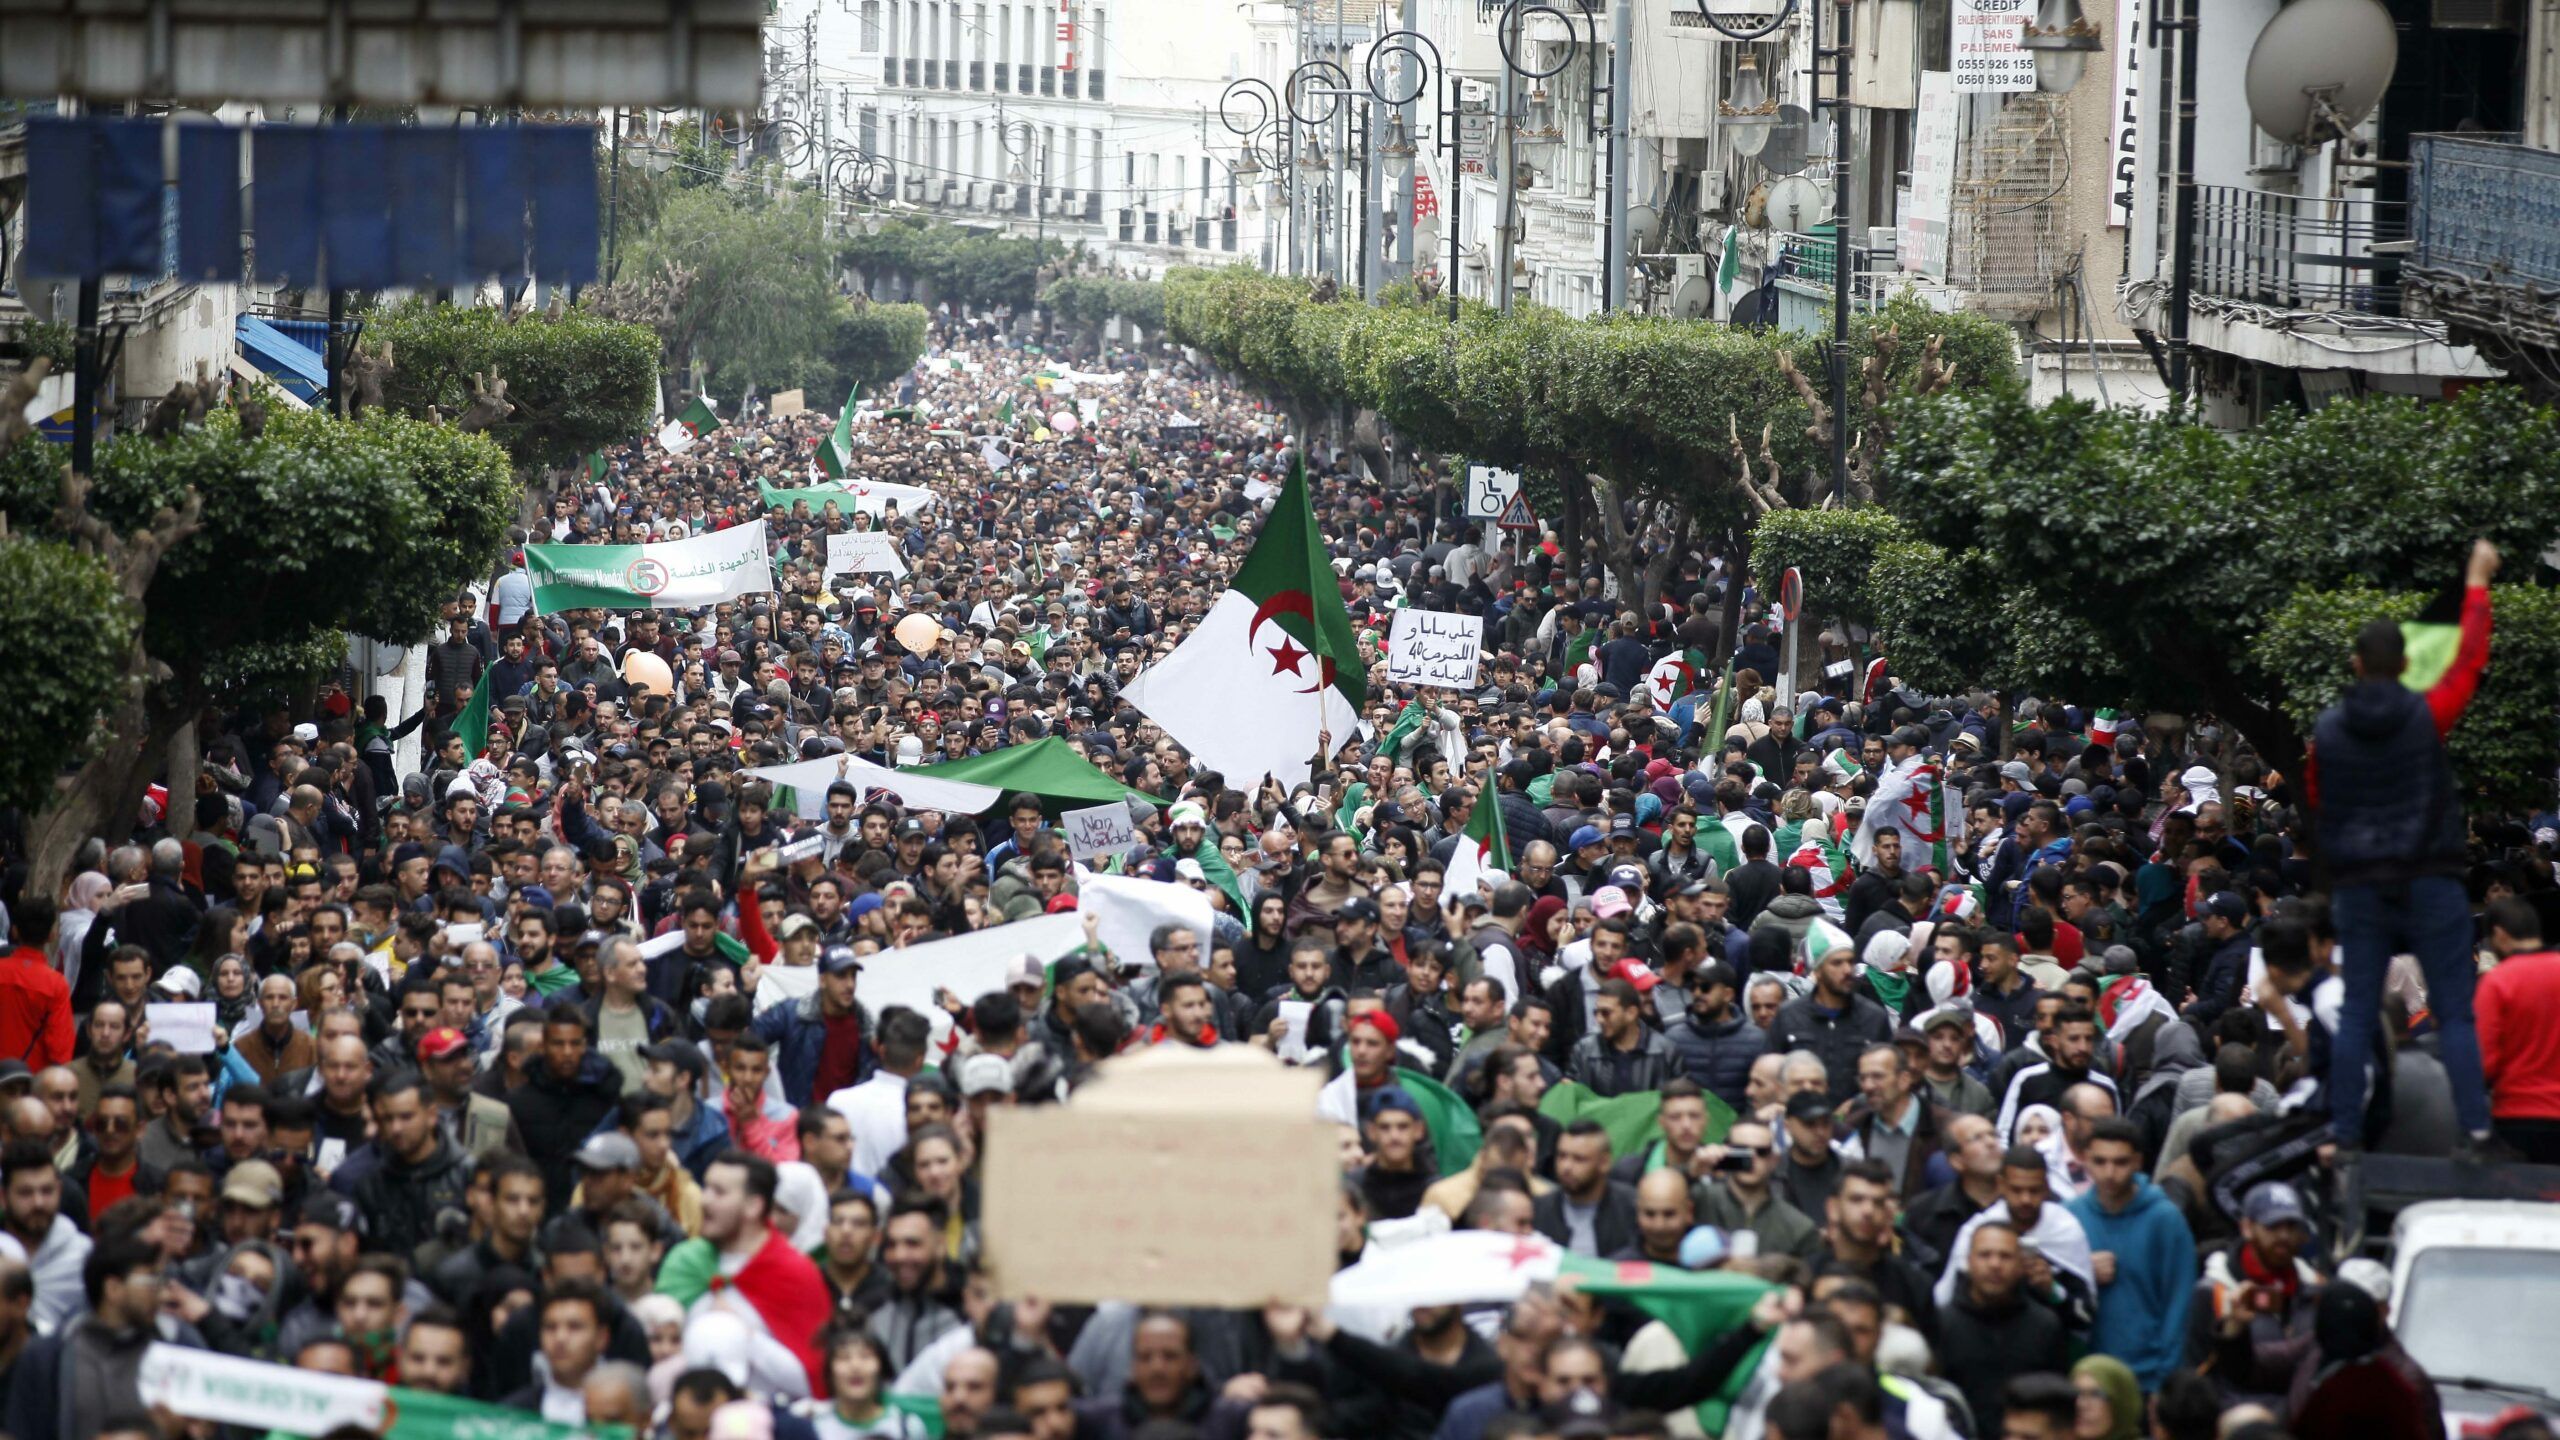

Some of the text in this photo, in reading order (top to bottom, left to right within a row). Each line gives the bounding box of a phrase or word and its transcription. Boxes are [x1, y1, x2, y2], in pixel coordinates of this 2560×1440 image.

[1974, 0, 2021, 11] CREDIT
[1957, 15, 2000, 25] ENLEVEMENT
[1983, 29, 2013, 39] SANS
[1960, 43, 2028, 53] PAIEMEN
[1957, 60, 2034, 69] 0555 926 155
[1957, 75, 2033, 84] 0560 939 480
[670, 547, 760, 578] لا للعهدة الخامسة
[1448, 620, 1475, 643] علي
[1409, 640, 1475, 663] اللصوص 40
[1430, 663, 1473, 683] النهاية
[1081, 815, 1113, 832] Non
